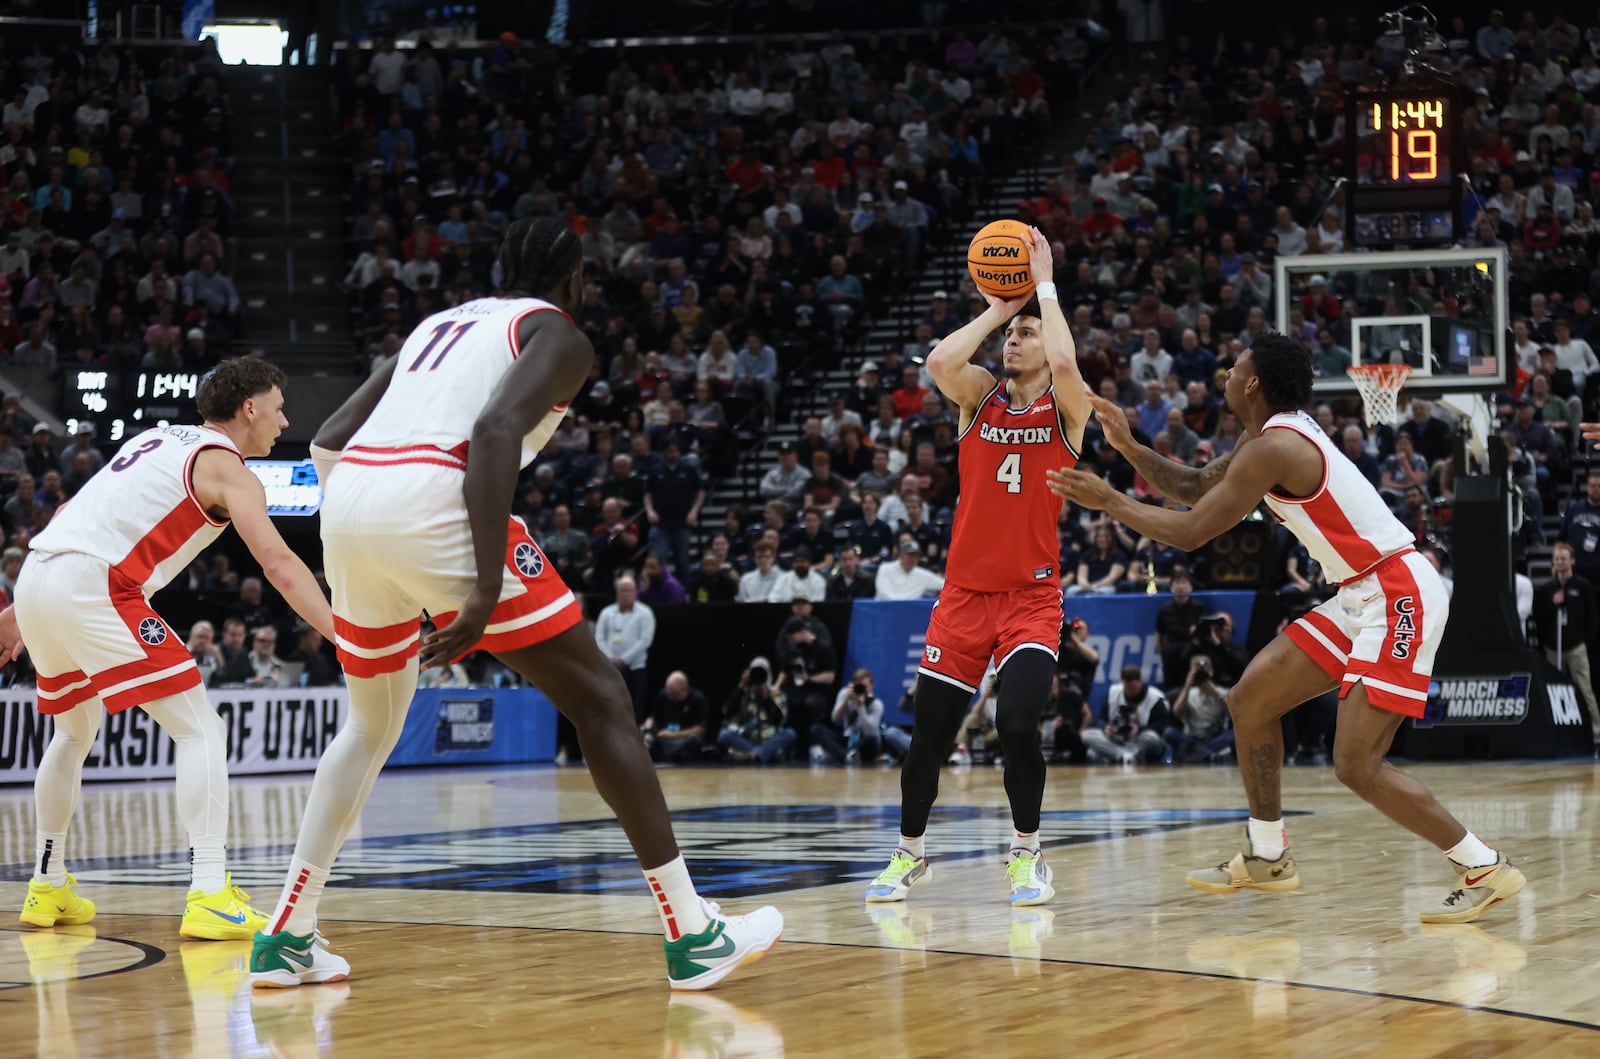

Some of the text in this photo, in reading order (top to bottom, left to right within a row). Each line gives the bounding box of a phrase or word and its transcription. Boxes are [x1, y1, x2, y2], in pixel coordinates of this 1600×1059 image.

[1374, 100, 1443, 131] 11:44
[1391, 130, 1438, 181] 19
[982, 246, 1020, 258] NCAA
[977, 269, 1029, 285] Wilson
[407, 320, 480, 372] 11
[137, 373, 198, 399] 11:44
[110, 419, 125, 441] 3
[979, 422, 1053, 445] DAYTON
[111, 438, 164, 472] 3
[995, 452, 1022, 494] 4
[1391, 595, 1416, 660] CATS
[1440, 680, 1500, 700] MARCH
[1546, 682, 1583, 726] NCAA
[1447, 697, 1527, 718] MADNESS
[262, 699, 338, 760] UTAH
